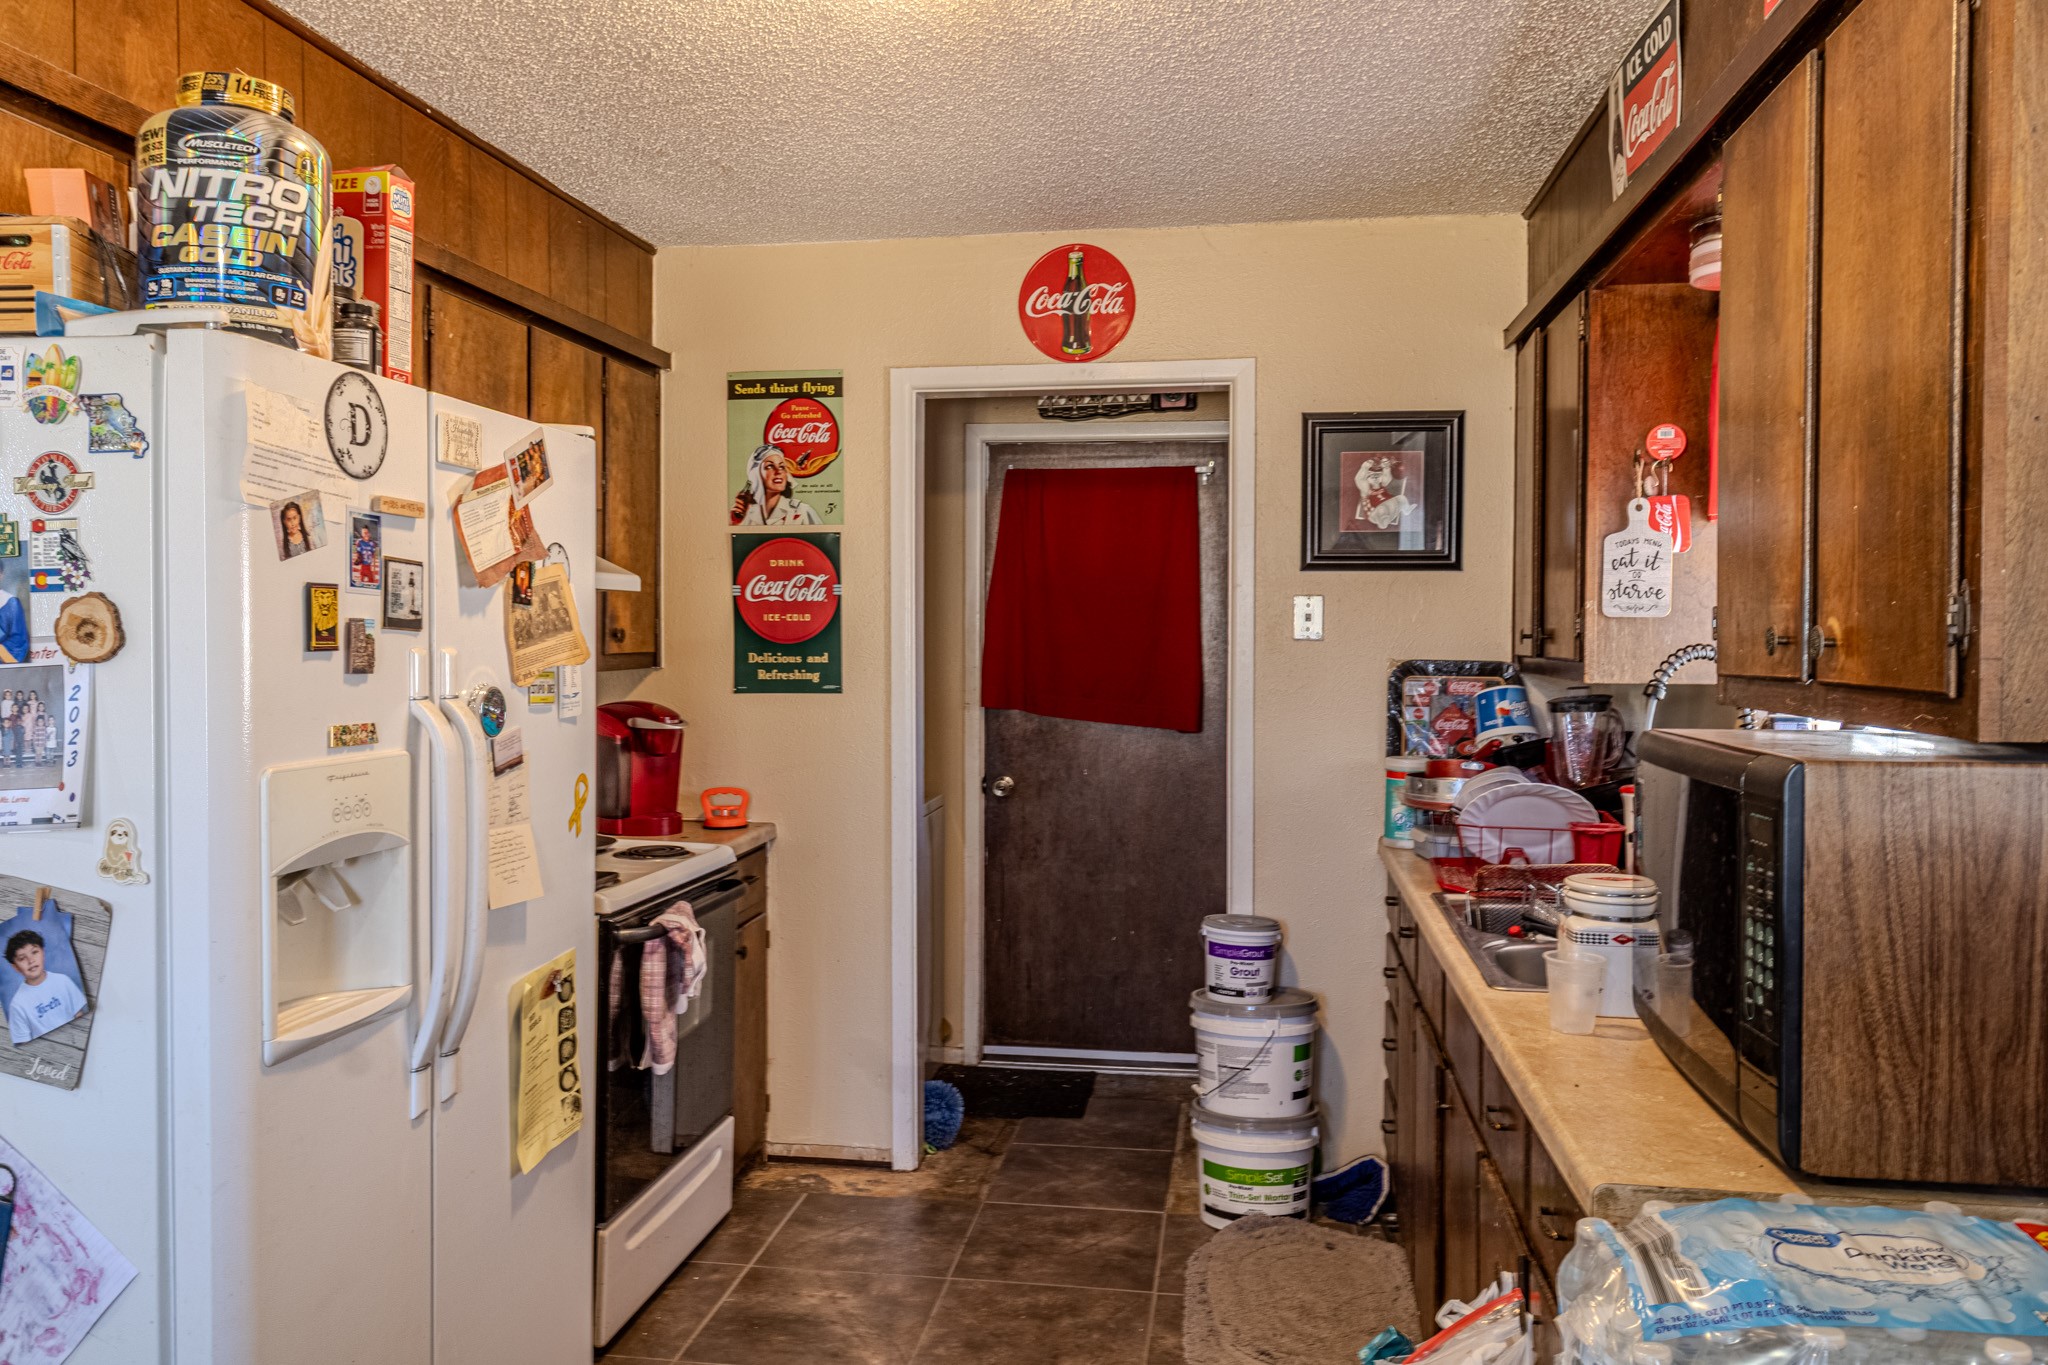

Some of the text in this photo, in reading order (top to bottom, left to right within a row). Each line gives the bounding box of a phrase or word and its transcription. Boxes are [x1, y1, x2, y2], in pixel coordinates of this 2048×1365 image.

[1627, 15, 1673, 86] ICE COLD
[236, 78, 251, 94] 14
[1626, 60, 1676, 158] Coca-Cola
[185, 139, 258, 153] MUSCLETECH
[177, 158, 245, 167] PERFORMANCE
[150, 167, 309, 213] NITRO
[334, 178, 358, 190] IZE
[189, 200, 303, 236] TECH
[151, 223, 298, 257] CASEIN
[179, 246, 263, 267] GOLD
[1025, 282, 1128, 318] Coca-Cola
[224, 305, 278, 319] VANILLA
[735, 382, 835, 395] Sends thirst flying
[349, 402, 371, 446] D
[768, 422, 833, 444] Coca-Cola
[1643, 538, 1662, 548] MENU
[1612, 547, 1663, 570] eat it
[745, 574, 830, 602] Coca-Cola
[1607, 580, 1666, 600] starve
[748, 652, 829, 663] Delicious and
[757, 669, 820, 683] Refreshing
[1230, 966, 1260, 976] Grout
[1225, 1170, 1284, 1184] SimpleSet
[1844, 1247, 1957, 1263] Drinking
[1706, 1308, 1718, 1317] OZ
[1731, 1302, 1743, 1311] PT
